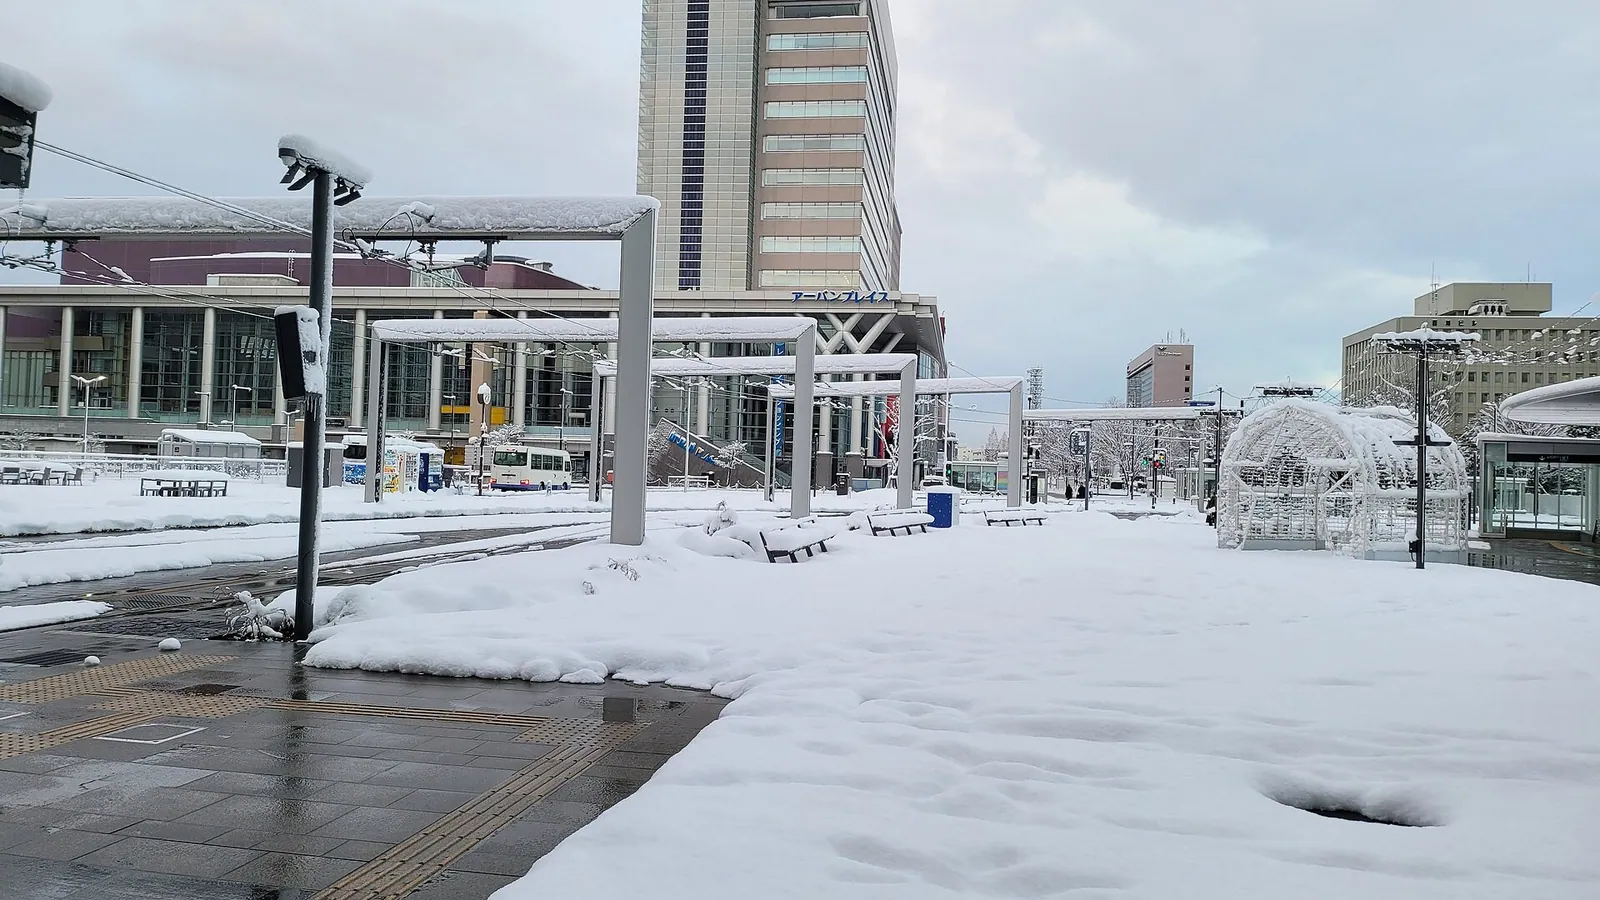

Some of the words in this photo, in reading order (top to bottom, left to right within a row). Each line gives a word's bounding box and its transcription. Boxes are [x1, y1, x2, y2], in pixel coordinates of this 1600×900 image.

[791, 290, 889, 304] アーバンプレイス
